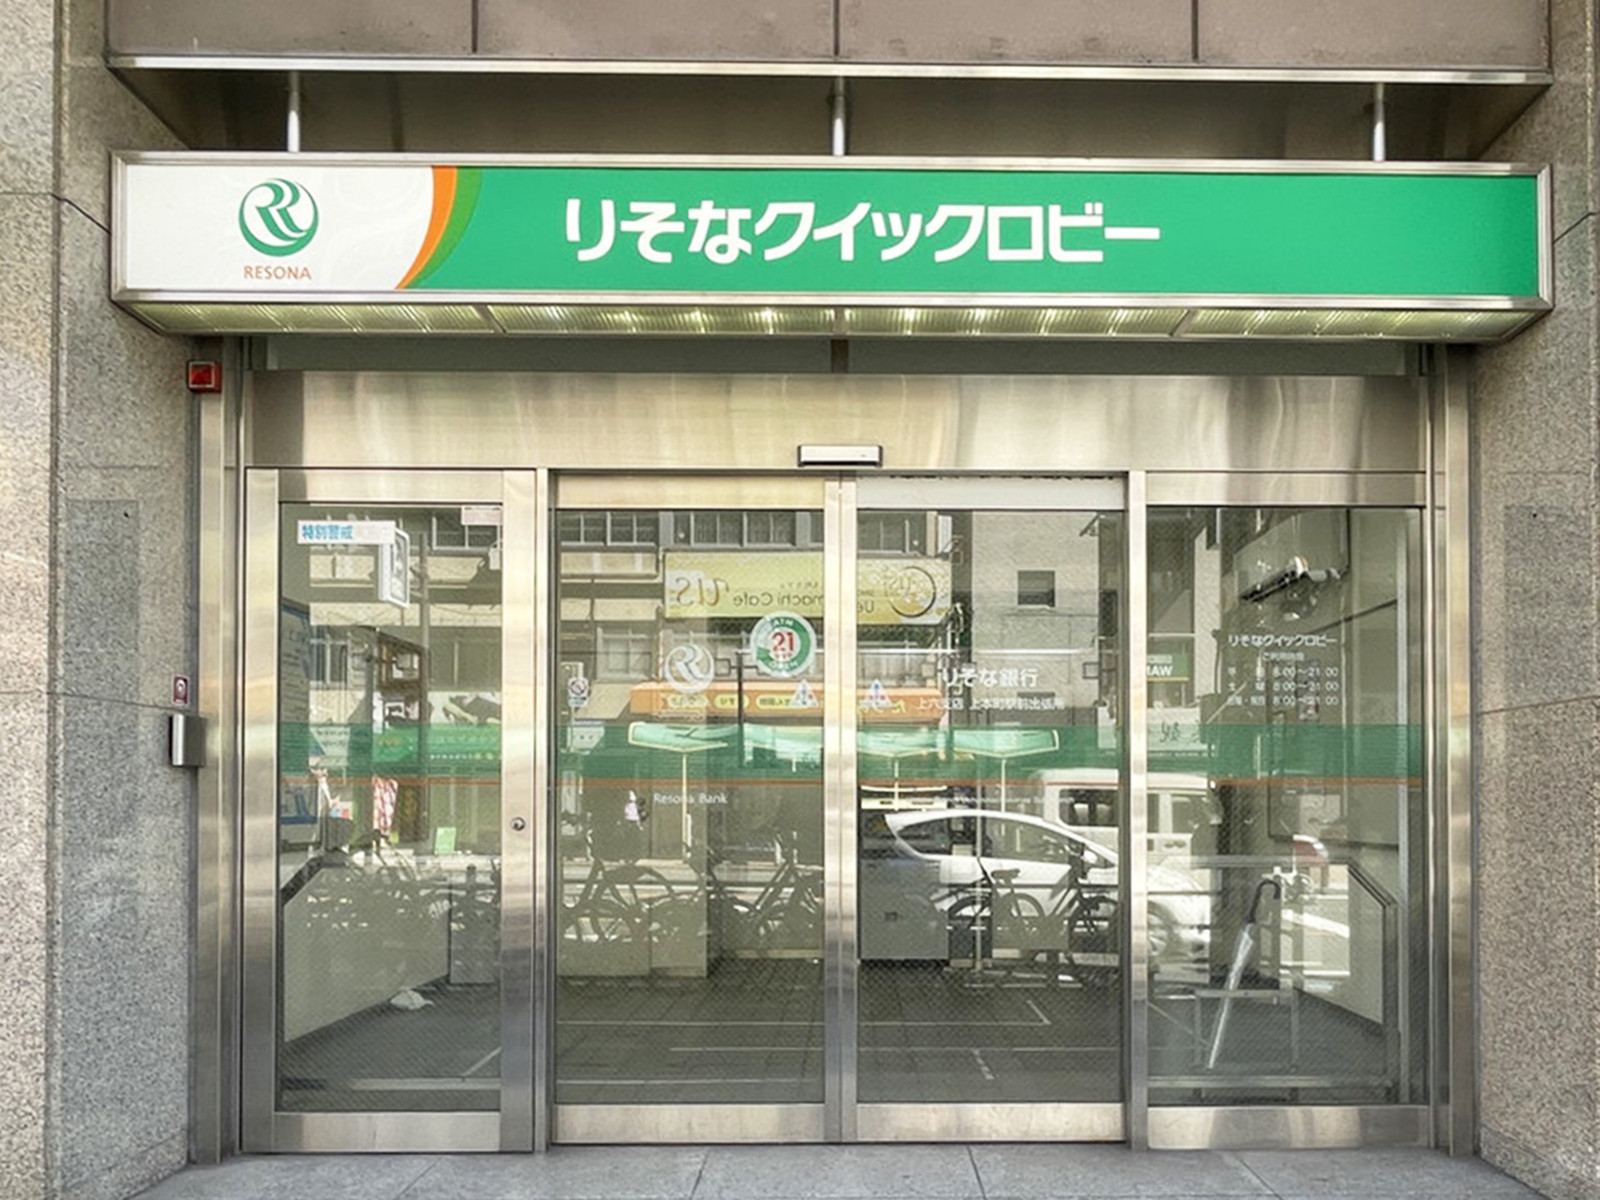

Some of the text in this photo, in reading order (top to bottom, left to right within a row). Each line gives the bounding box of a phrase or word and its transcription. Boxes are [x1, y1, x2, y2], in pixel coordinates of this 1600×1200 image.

[565, 199, 1161, 264] りそなクイックロビー
[243, 265, 313, 280] RESONA
[302, 524, 353, 540] 特別警戒
[772, 618, 795, 627] ATM
[772, 631, 795, 651] 21
[1228, 634, 1338, 647] りそなクイックロビー
[942, 667, 1039, 688] りそな銀行
[653, 792, 728, 804] Resoa Bank
